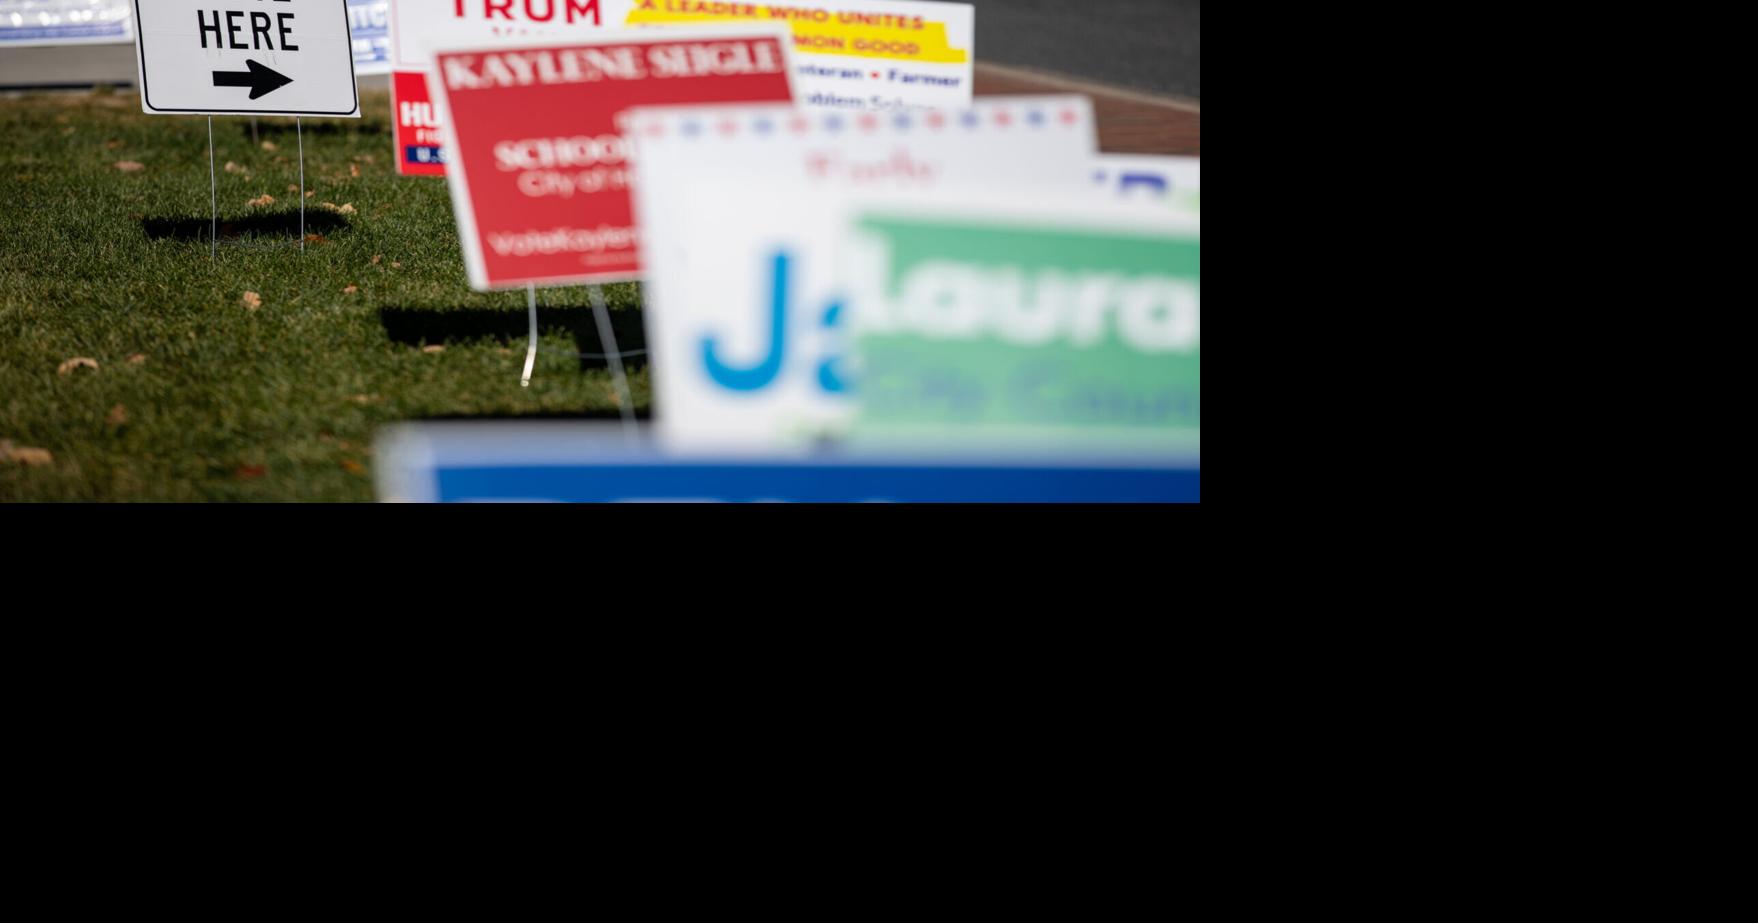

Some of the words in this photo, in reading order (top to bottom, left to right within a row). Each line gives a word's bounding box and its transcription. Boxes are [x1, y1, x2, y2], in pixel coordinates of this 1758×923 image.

[197, 9, 300, 52] HERE
[638, 0, 658, 11] A
[666, 0, 758, 18] LEADER
[767, 5, 830, 23] WHO
[837, 9, 926, 31] UNITES
[852, 37, 921, 56] GOOD
[444, 48, 649, 91] KAYLENE
[888, 68, 962, 88] Farmer
[493, 134, 632, 173] SCHOO
[853, 226, 1199, 354] Laura
